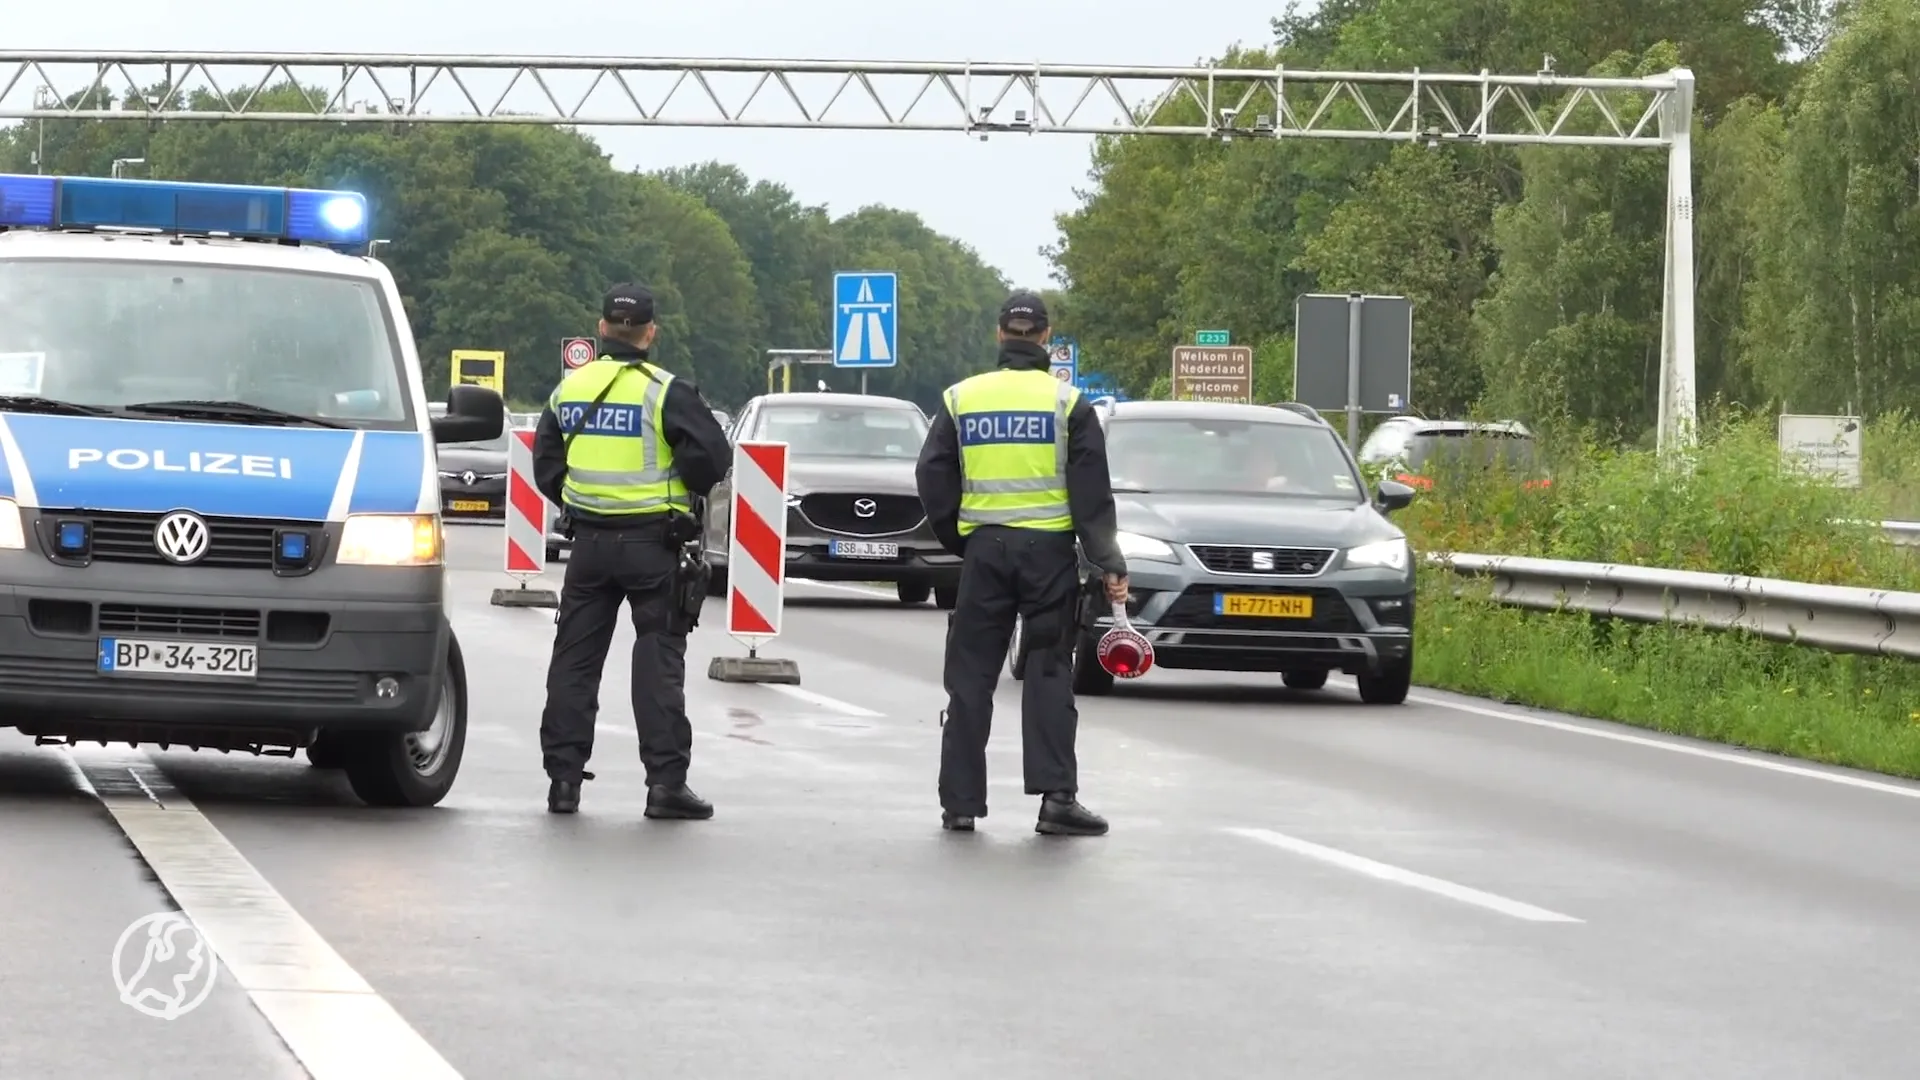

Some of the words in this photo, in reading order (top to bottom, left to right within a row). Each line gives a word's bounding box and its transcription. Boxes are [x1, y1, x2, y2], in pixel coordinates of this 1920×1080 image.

[1199, 334, 1226, 343] E233
[570, 348, 588, 360] 100
[1180, 351, 1228, 362] Welkom
[1232, 351, 1244, 362] in
[1180, 364, 1244, 374] Nederland
[1186, 381, 1239, 392] welcome
[1178, 393, 1247, 404] llkommen
[965, 416, 1047, 440] POLIZEI
[68, 448, 293, 479] POLIZEI
[837, 542, 856, 554] BSB
[863, 543, 876, 555] JL
[878, 544, 897, 555] 530
[1230, 597, 1304, 614] H-771-NH
[1099, 632, 1152, 656] BUNDESPOLIZEI
[117, 643, 149, 667] BP
[165, 645, 254, 672] 34-320
